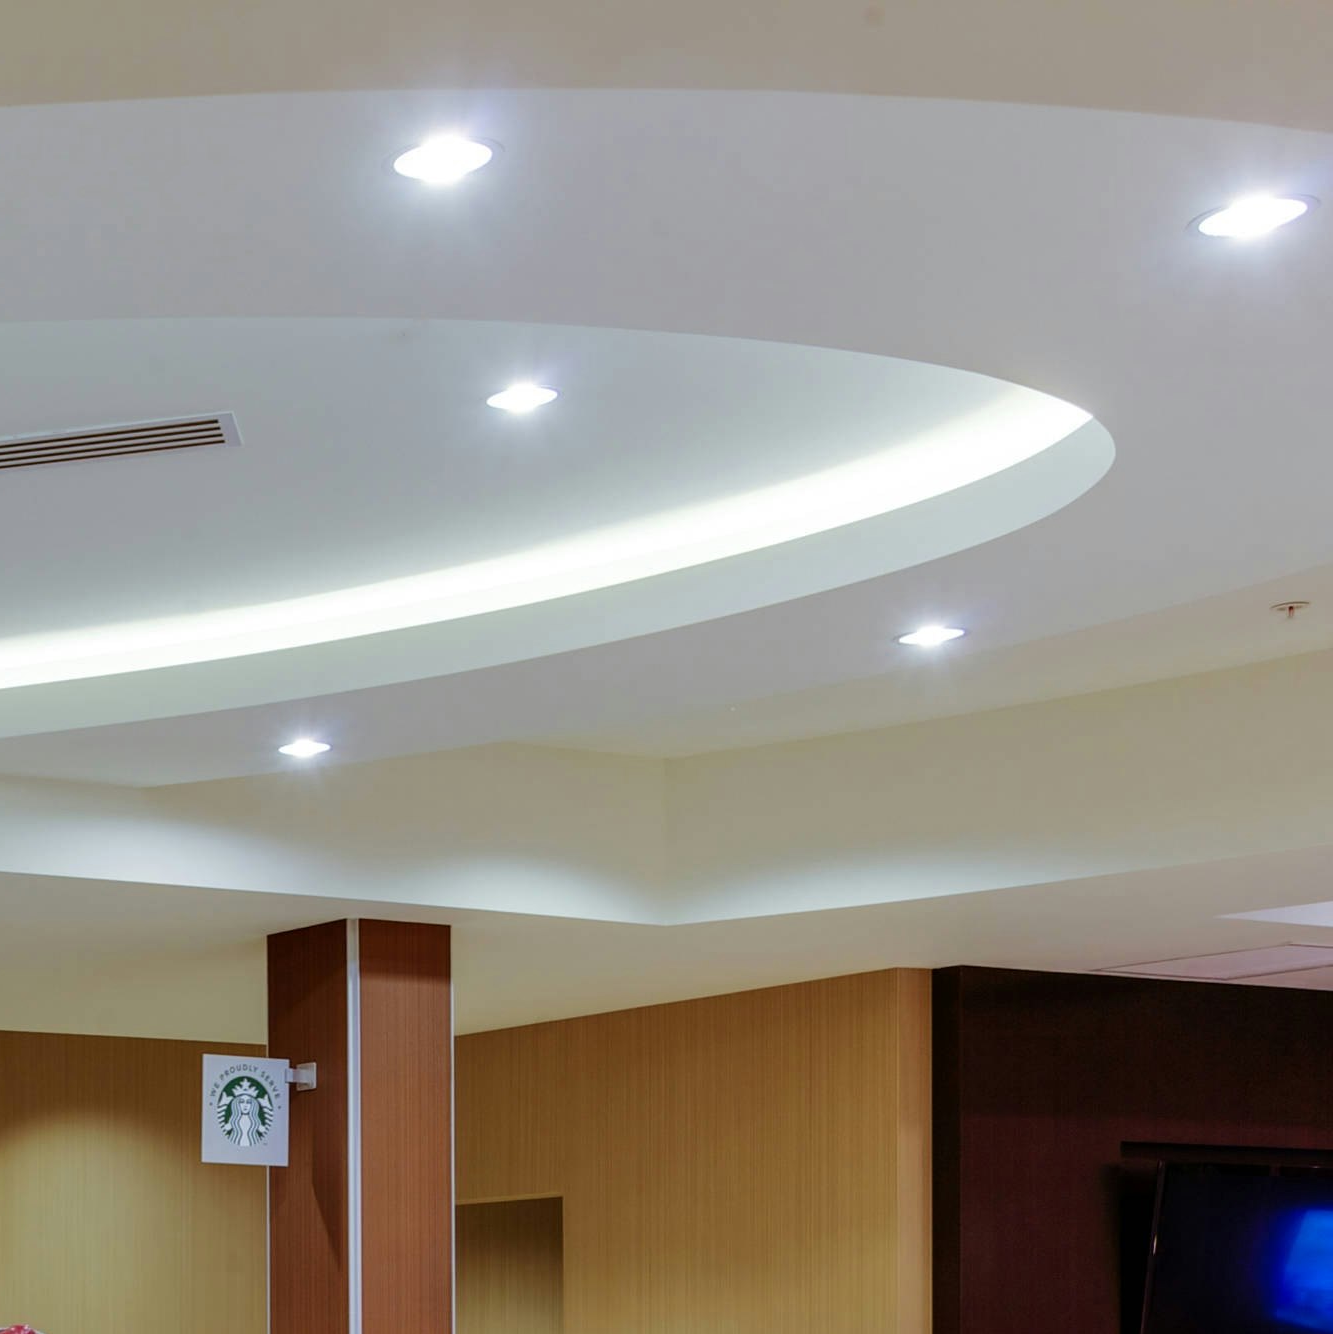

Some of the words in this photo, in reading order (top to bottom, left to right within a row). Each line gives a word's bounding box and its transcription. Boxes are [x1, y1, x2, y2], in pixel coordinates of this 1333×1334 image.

[209, 1082, 220, 1097] WE
[219, 1063, 258, 1081] PROUDLY
[260, 1071, 281, 1099] SERVE
